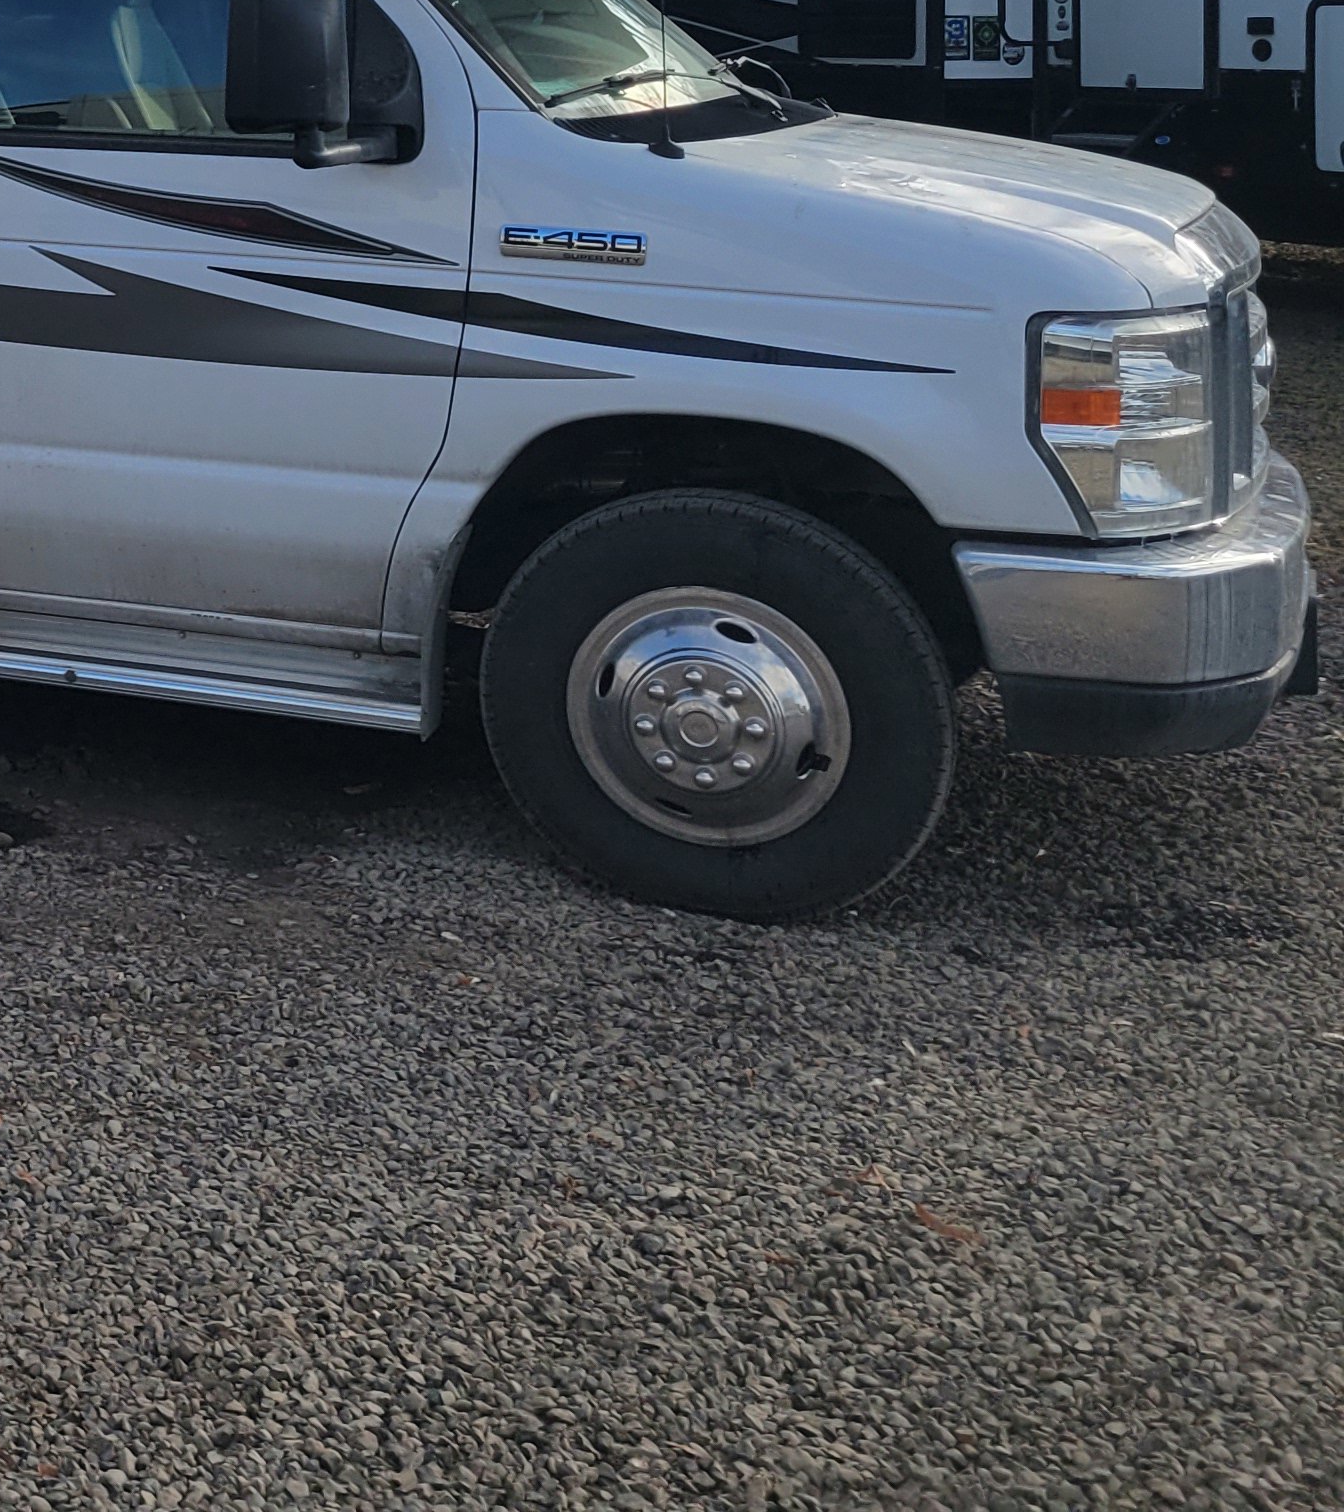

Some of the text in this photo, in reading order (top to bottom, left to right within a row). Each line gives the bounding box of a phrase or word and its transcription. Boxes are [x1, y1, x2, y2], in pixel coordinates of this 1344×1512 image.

[503, 226, 643, 254] E-450
[563, 252, 641, 264] SUPER DUTY
